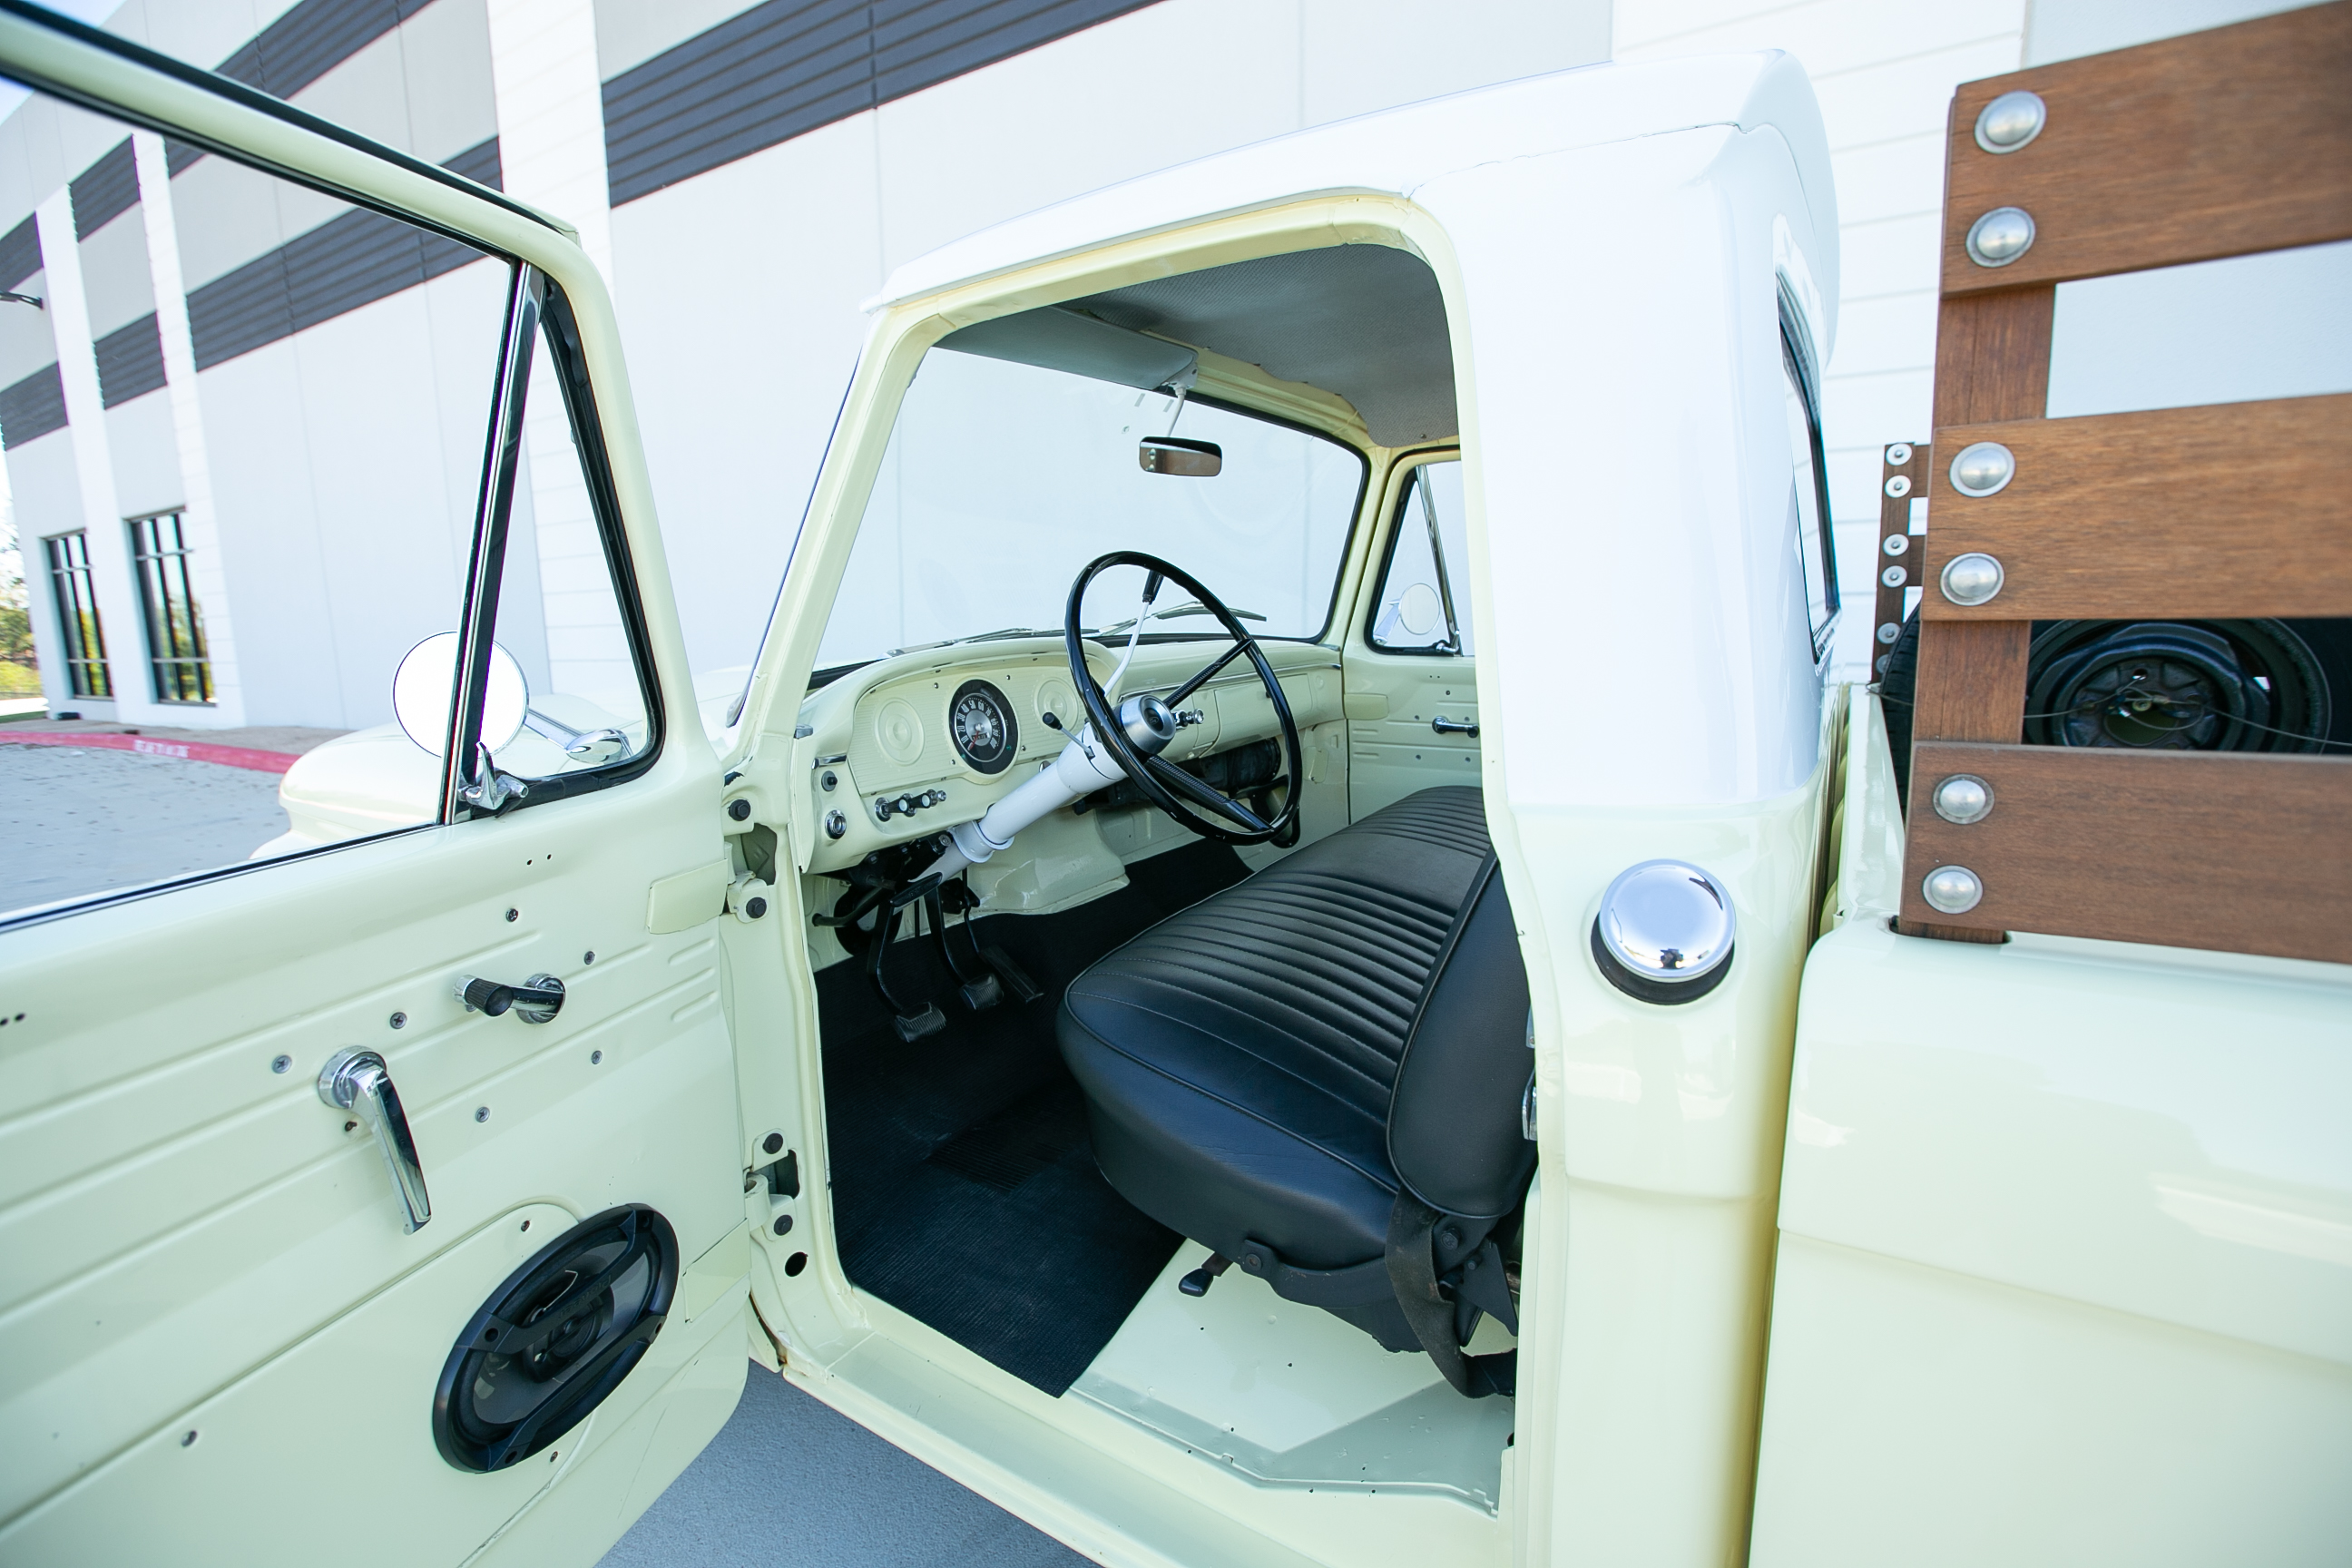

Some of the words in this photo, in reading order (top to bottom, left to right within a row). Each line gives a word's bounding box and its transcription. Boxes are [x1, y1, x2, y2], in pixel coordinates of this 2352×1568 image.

[956, 712, 965, 722] 30
[990, 718, 997, 726] 80
[992, 728, 999, 737] 90
